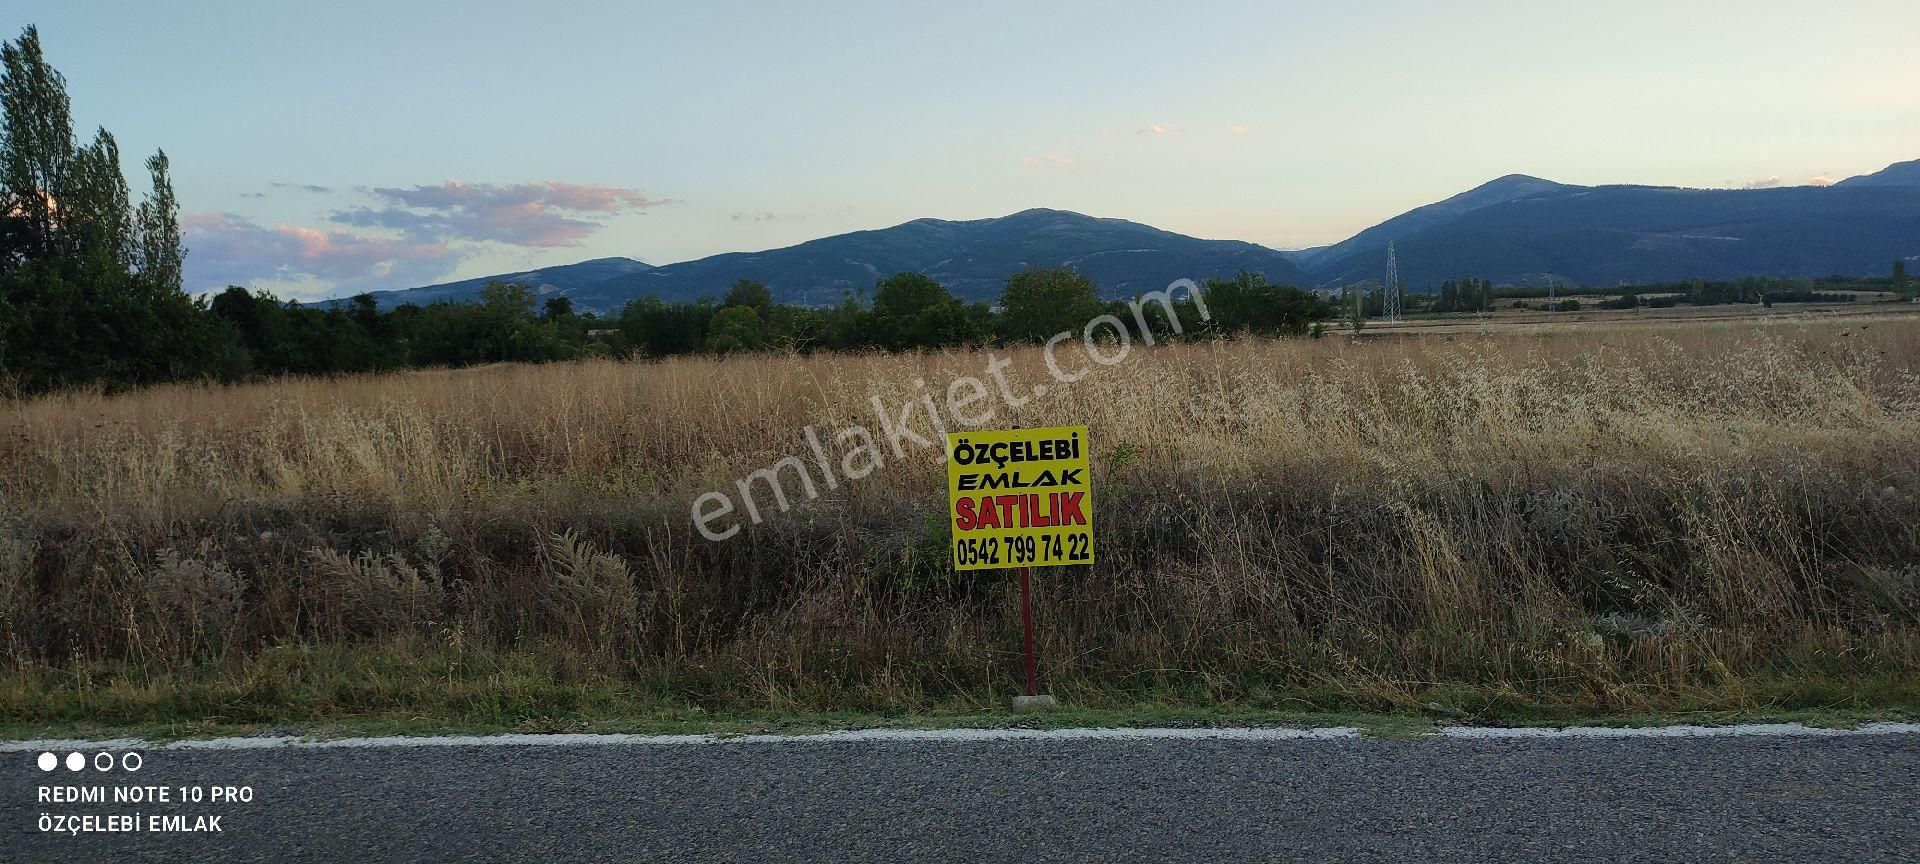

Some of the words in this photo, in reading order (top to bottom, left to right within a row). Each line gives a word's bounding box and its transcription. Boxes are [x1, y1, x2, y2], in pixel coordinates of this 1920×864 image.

[953, 431, 1080, 469] ÖZÇELEBİ
[957, 468, 1084, 491] EMLAK
[955, 491, 1087, 531] SATILIK
[957, 537, 1000, 565] 0542
[1004, 535, 1036, 563] 799
[1041, 534, 1063, 561] 74
[1067, 532, 1090, 560] 22
